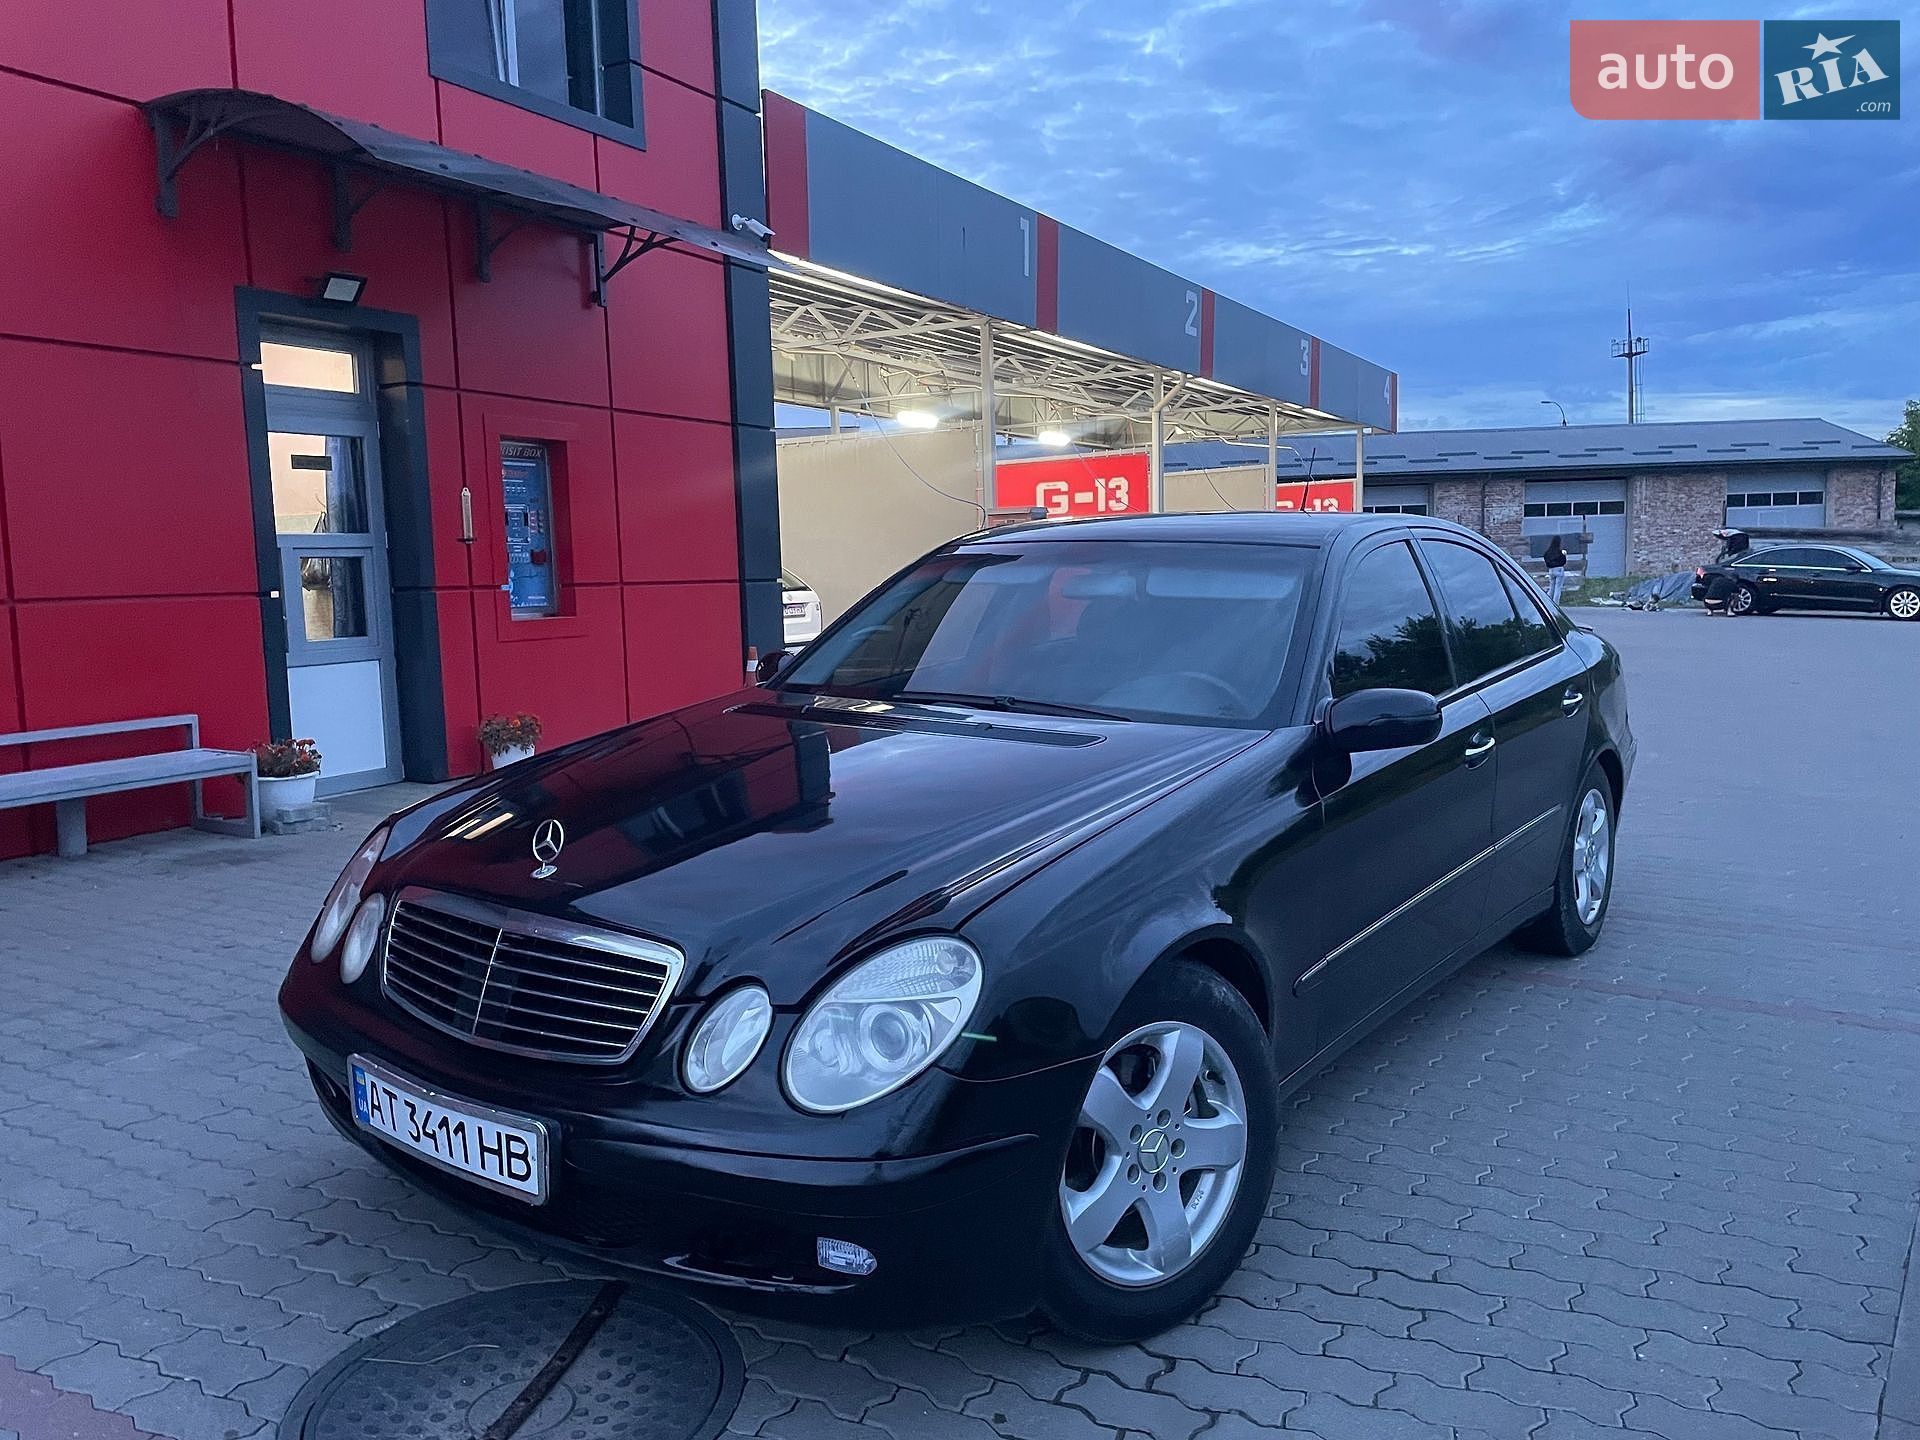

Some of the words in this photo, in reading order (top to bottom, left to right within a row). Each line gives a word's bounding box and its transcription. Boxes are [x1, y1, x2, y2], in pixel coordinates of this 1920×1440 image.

[1020, 216, 1030, 277] 1
[1184, 289, 1198, 337] 2
[1300, 338, 1309, 376] 3
[1383, 375, 1390, 405] 4
[1035, 475, 1130, 515] G-13
[358, 1097, 369, 1115] UA
[370, 1081, 397, 1132] AT
[404, 1099, 469, 1164] 3411
[477, 1125, 532, 1182] HB
